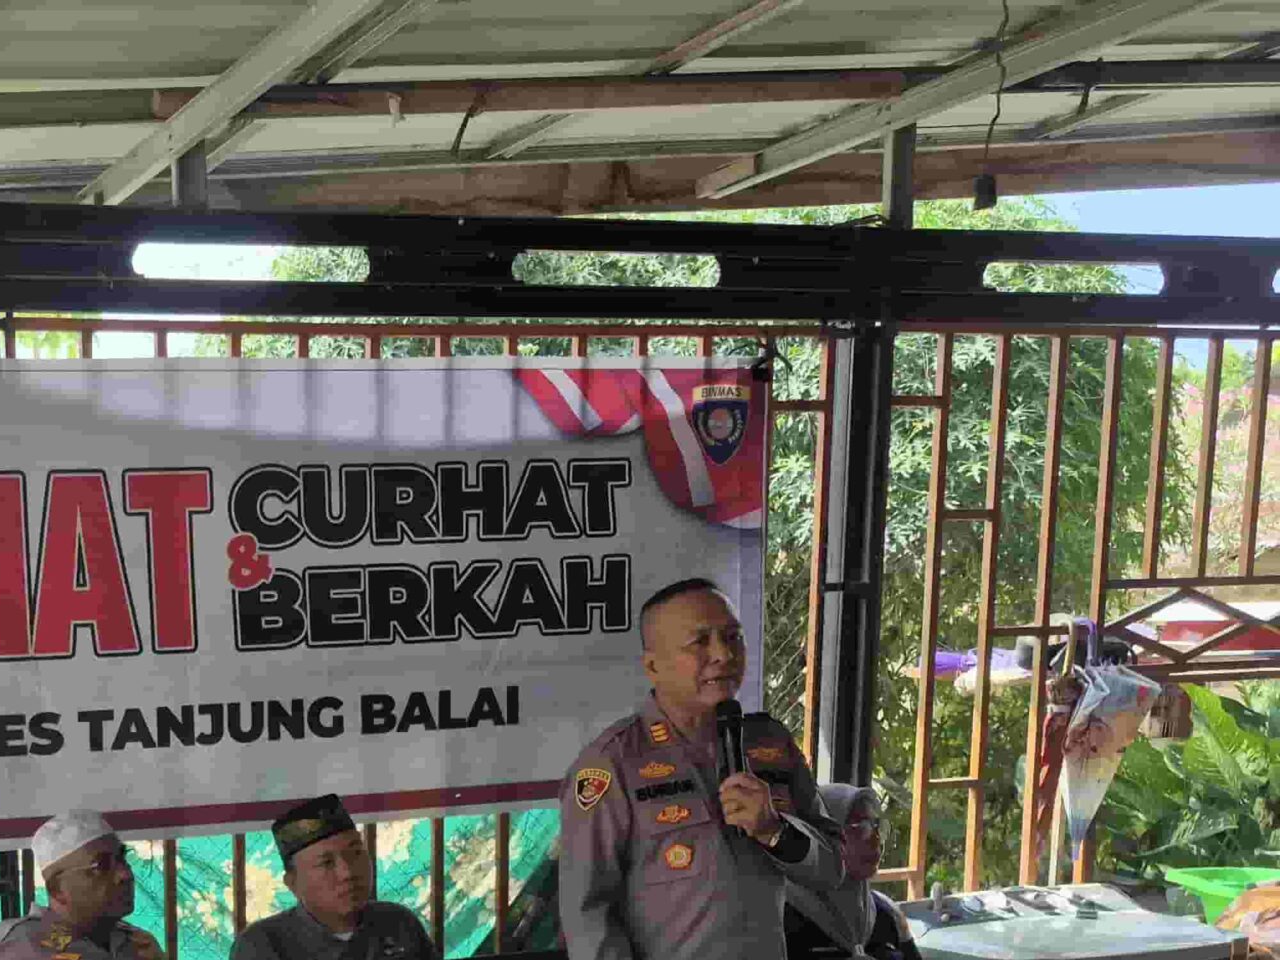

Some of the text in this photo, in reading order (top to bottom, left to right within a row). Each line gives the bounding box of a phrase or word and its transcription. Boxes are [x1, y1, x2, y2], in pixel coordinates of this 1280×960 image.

[229, 458, 631, 550] CURHAT
[227, 532, 631, 652] & BERKAH
[77, 697, 345, 752] TANJUNG
[361, 685, 520, 735] BALAI
